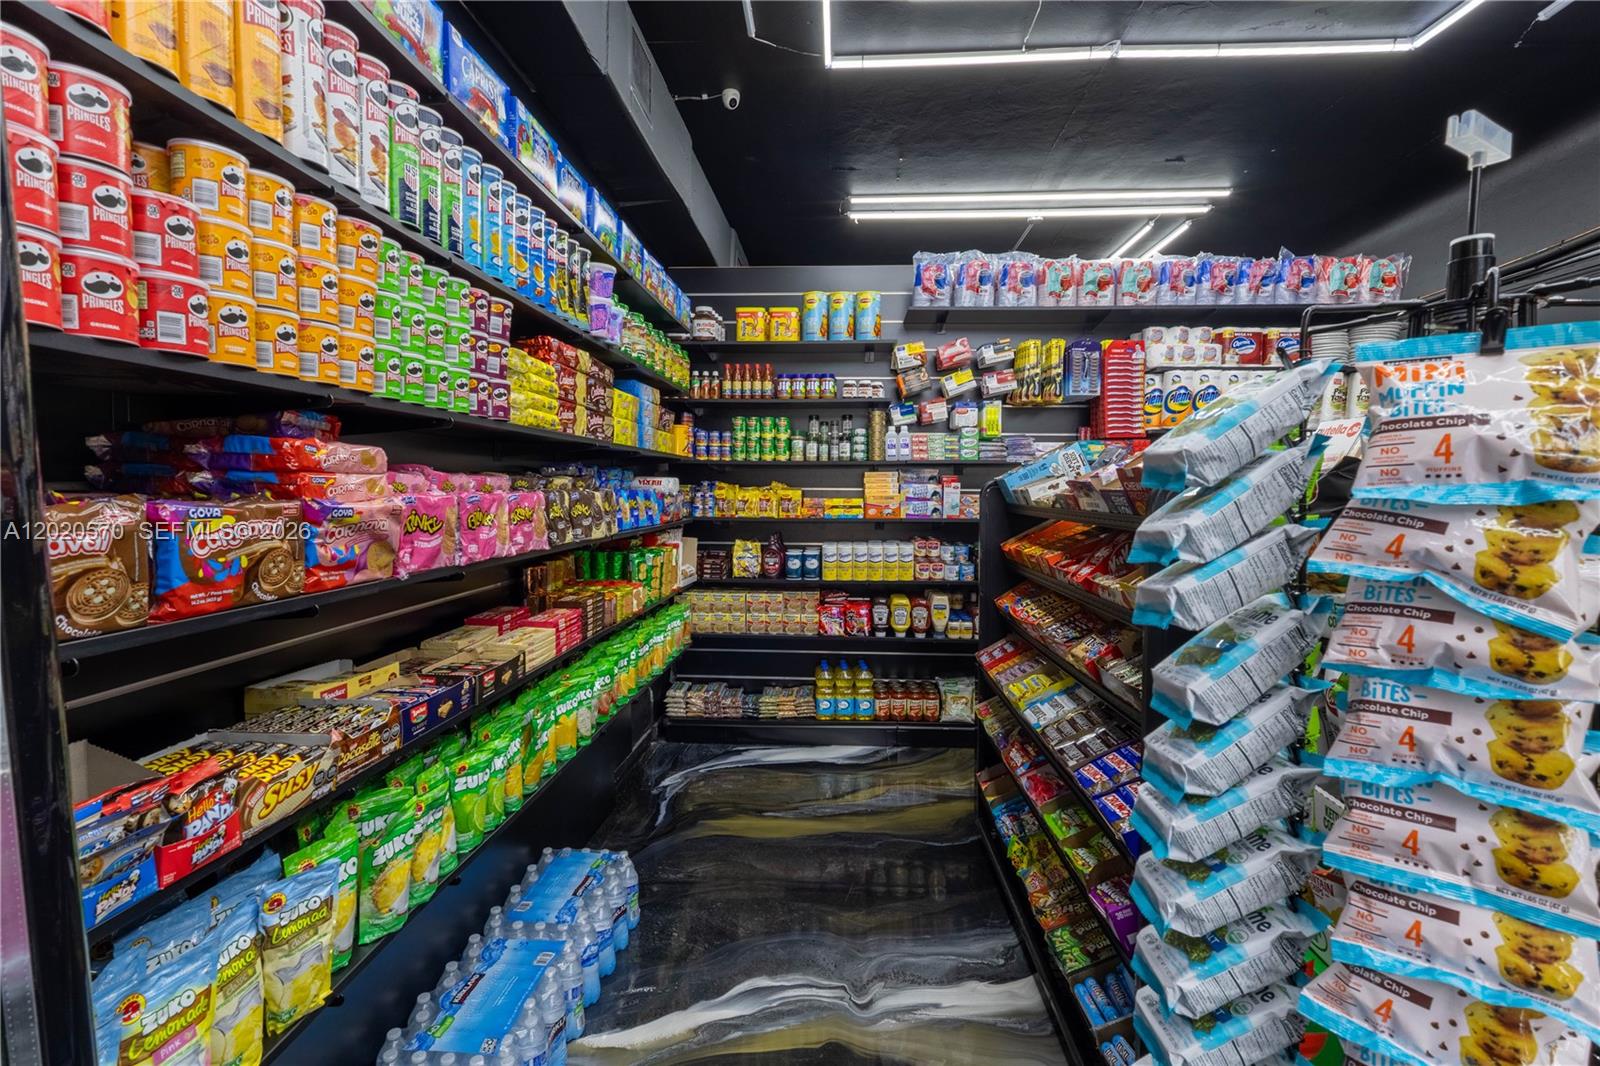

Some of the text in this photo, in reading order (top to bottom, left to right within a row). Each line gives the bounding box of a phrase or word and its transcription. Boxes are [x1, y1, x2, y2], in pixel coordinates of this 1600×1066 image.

[67, 107, 111, 132] PRINGLES
[74, 134, 108, 148] ORIGINAL
[16, 171, 55, 198] PRINGLES
[93, 207, 128, 230] PRINGLES
[165, 235, 195, 256] PRINGLES
[22, 269, 51, 289] INGLES
[82, 293, 124, 315] PRINGLES
[90, 321, 120, 331] ORIGINAL
[219, 324, 250, 341] PRINGLES
[1436, 417, 1467, 426] Chip
[1380, 446, 1400, 455] NO
[1434, 433, 1454, 464] 4
[1380, 468, 1401, 477] NO
[189, 508, 222, 518] GOYA
[332, 508, 354, 517] GOYA
[1343, 509, 1425, 529] Chocolate Chip
[1340, 533, 1357, 542] NO
[1385, 533, 1406, 559] 4
[1335, 552, 1353, 561] NO
[1346, 603, 1432, 620] Chocolate Chip
[1351, 628, 1368, 636] NO
[1396, 623, 1416, 654] 4
[1401, 706, 1429, 720] Chip
[1351, 726, 1368, 735] NO
[1398, 725, 1416, 752] 4
[1349, 746, 1368, 754] NO
[188, 798, 214, 823] Hello
[1404, 809, 1433, 825] Chip
[1352, 824, 1370, 835] NO
[372, 830, 415, 866] ZUKO
[1401, 829, 1420, 856] 4
[1353, 883, 1406, 907] Chocolate
[1408, 900, 1437, 916] Chip
[280, 896, 321, 926] ZUKO
[1356, 910, 1374, 923] NO
[1404, 919, 1423, 948] 4
[1333, 979, 1346, 993] NO
[1384, 980, 1411, 999] Chip
[140, 990, 196, 1035] ZUKO
[1374, 998, 1394, 1023] 4
